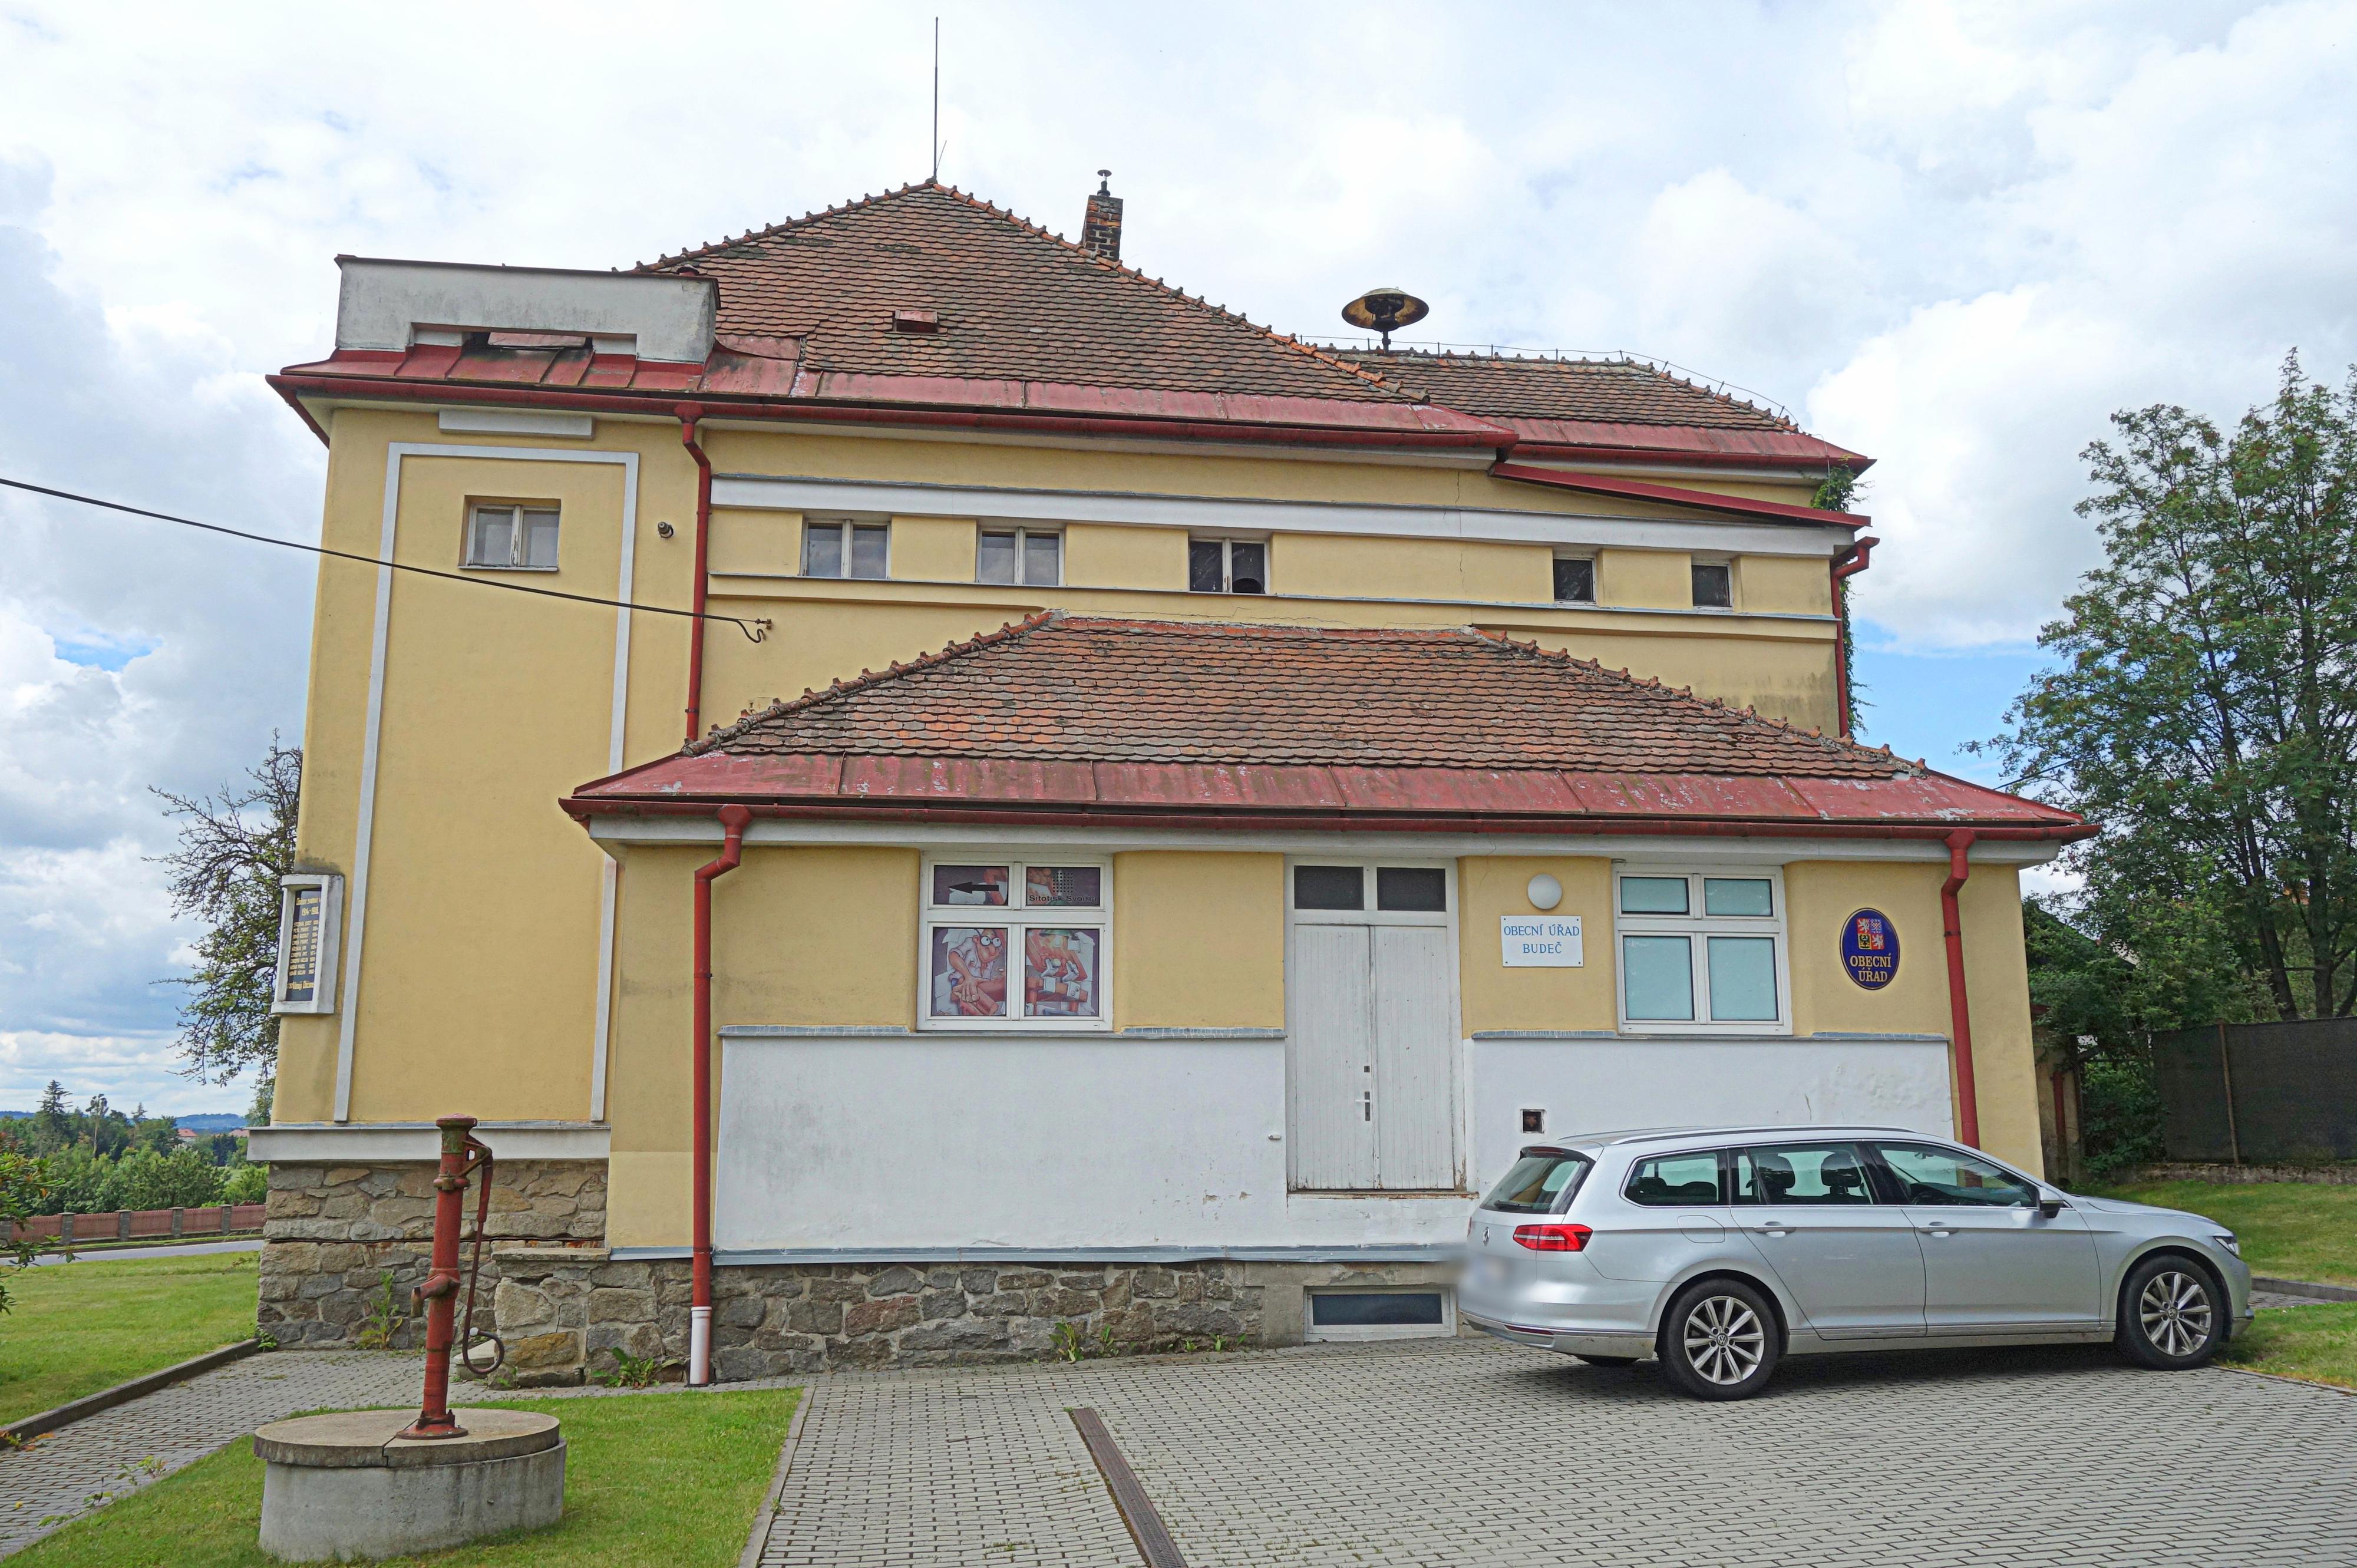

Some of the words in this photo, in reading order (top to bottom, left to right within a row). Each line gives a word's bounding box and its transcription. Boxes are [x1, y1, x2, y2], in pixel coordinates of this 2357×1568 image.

[1504, 923, 1543, 936] OBECNÍ
[1549, 924, 1580, 936] ÚŘAD
[1523, 942, 1562, 954] BUDEČ
[1850, 953, 1891, 968] OBECNÍ
[1858, 967, 1888, 982] ÚŘAD
[1717, 1334, 1727, 1345] VW
